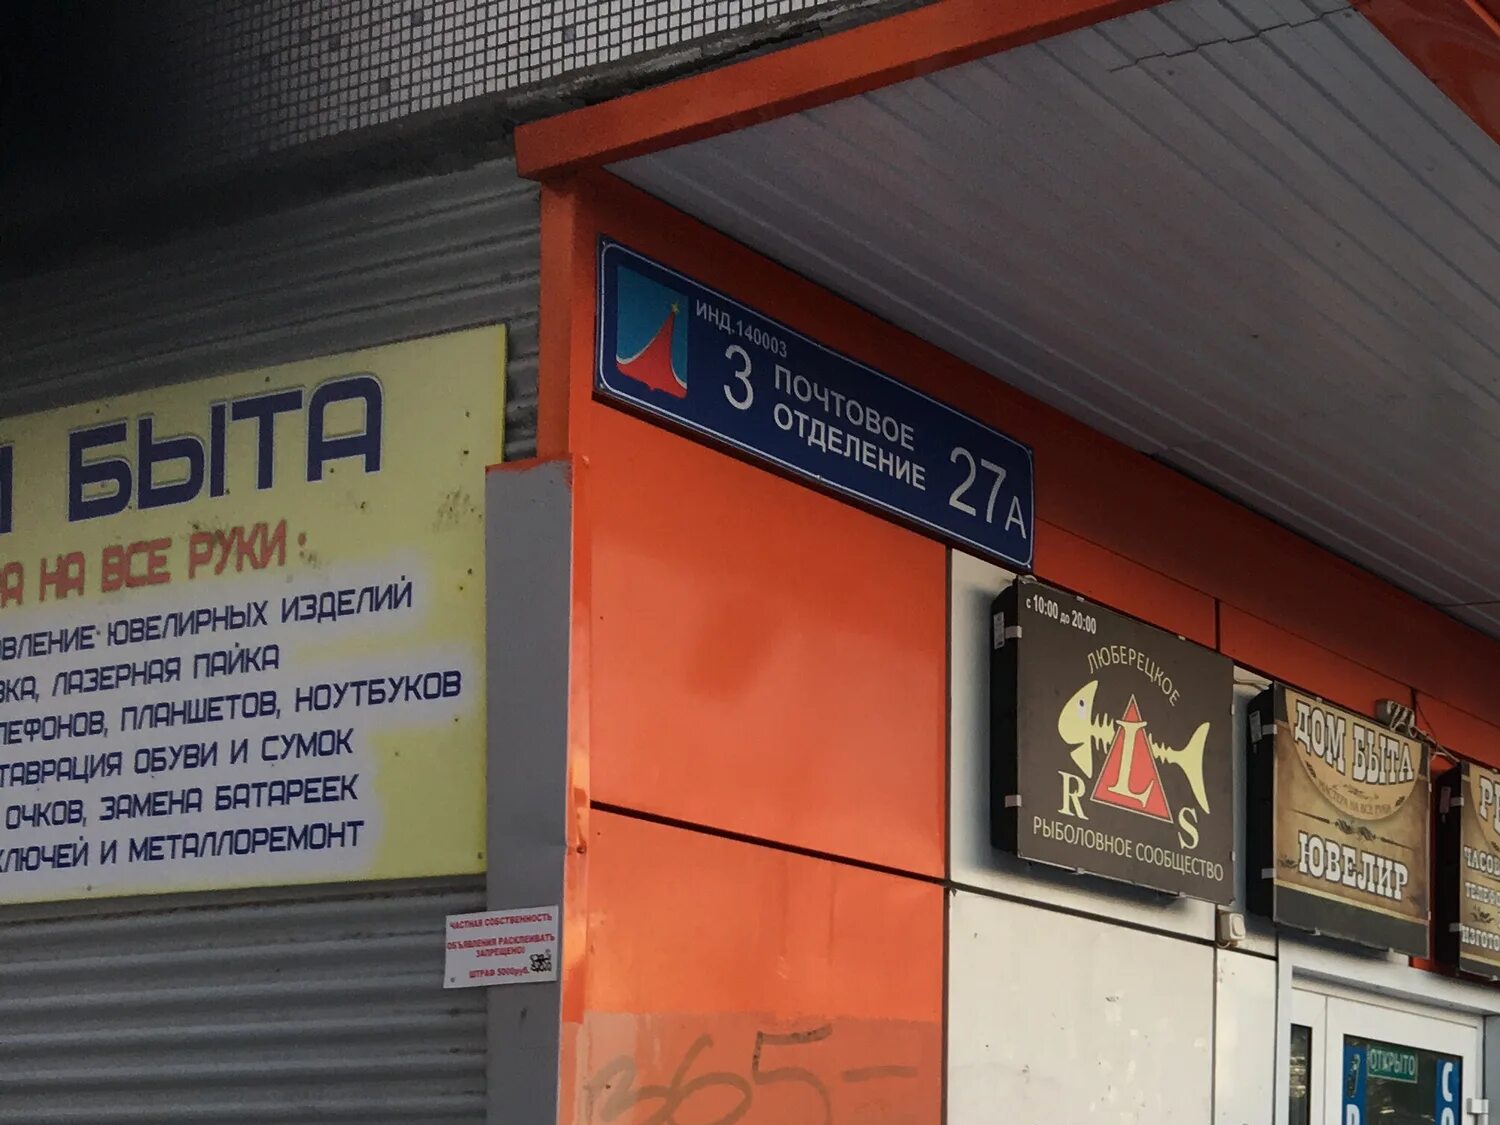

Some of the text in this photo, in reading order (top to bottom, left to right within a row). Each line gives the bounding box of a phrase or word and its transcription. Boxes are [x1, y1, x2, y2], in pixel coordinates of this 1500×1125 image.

[695, 299, 787, 358] ИНД.140003
[723, 344, 754, 411] 3
[774, 363, 915, 451] ПОЧТОВОЕ
[68, 375, 383, 522] БЫТА
[773, 403, 926, 491] ОТДЕЛЕНИЕ
[39, 551, 85, 603] НА
[102, 537, 172, 593] ВСЕ
[0, 575, 413, 661] ВЛЕНИЕ ЮВЕЛИРНЫХ ИЗДЕЛИЙ
[1033, 594, 1058, 619] 10:00
[1072, 610, 1097, 635] 20:00
[52, 657, 182, 697] ЛАЗЕРНАЯ
[193, 641, 280, 679] ПАЙКА
[121, 690, 281, 732] ПЛАНШЕТОВ,
[295, 670, 462, 713] НОУТБУКОВ
[1087, 645, 1181, 707] ЛЮБЕРЕЦКОЕ
[134, 741, 218, 774] ОБУВИ
[230, 739, 248, 765] И
[261, 728, 354, 762] СУМОК
[1294, 698, 1415, 785] ДОМ БЫТА
[5, 773, 359, 830] ОЧКОВ, ЗАМЕНА БАТАРЕЕК
[100, 839, 117, 865] И
[128, 820, 365, 863] МЕТАЛЛОРЕМОНТ
[1033, 815, 1224, 882] РЫБОЛОВНОЕ СООБЩЕСТВО
[1297, 829, 1409, 902] ЮВЕЛИР
[1369, 1048, 1416, 1076] ОТКРЫТО
